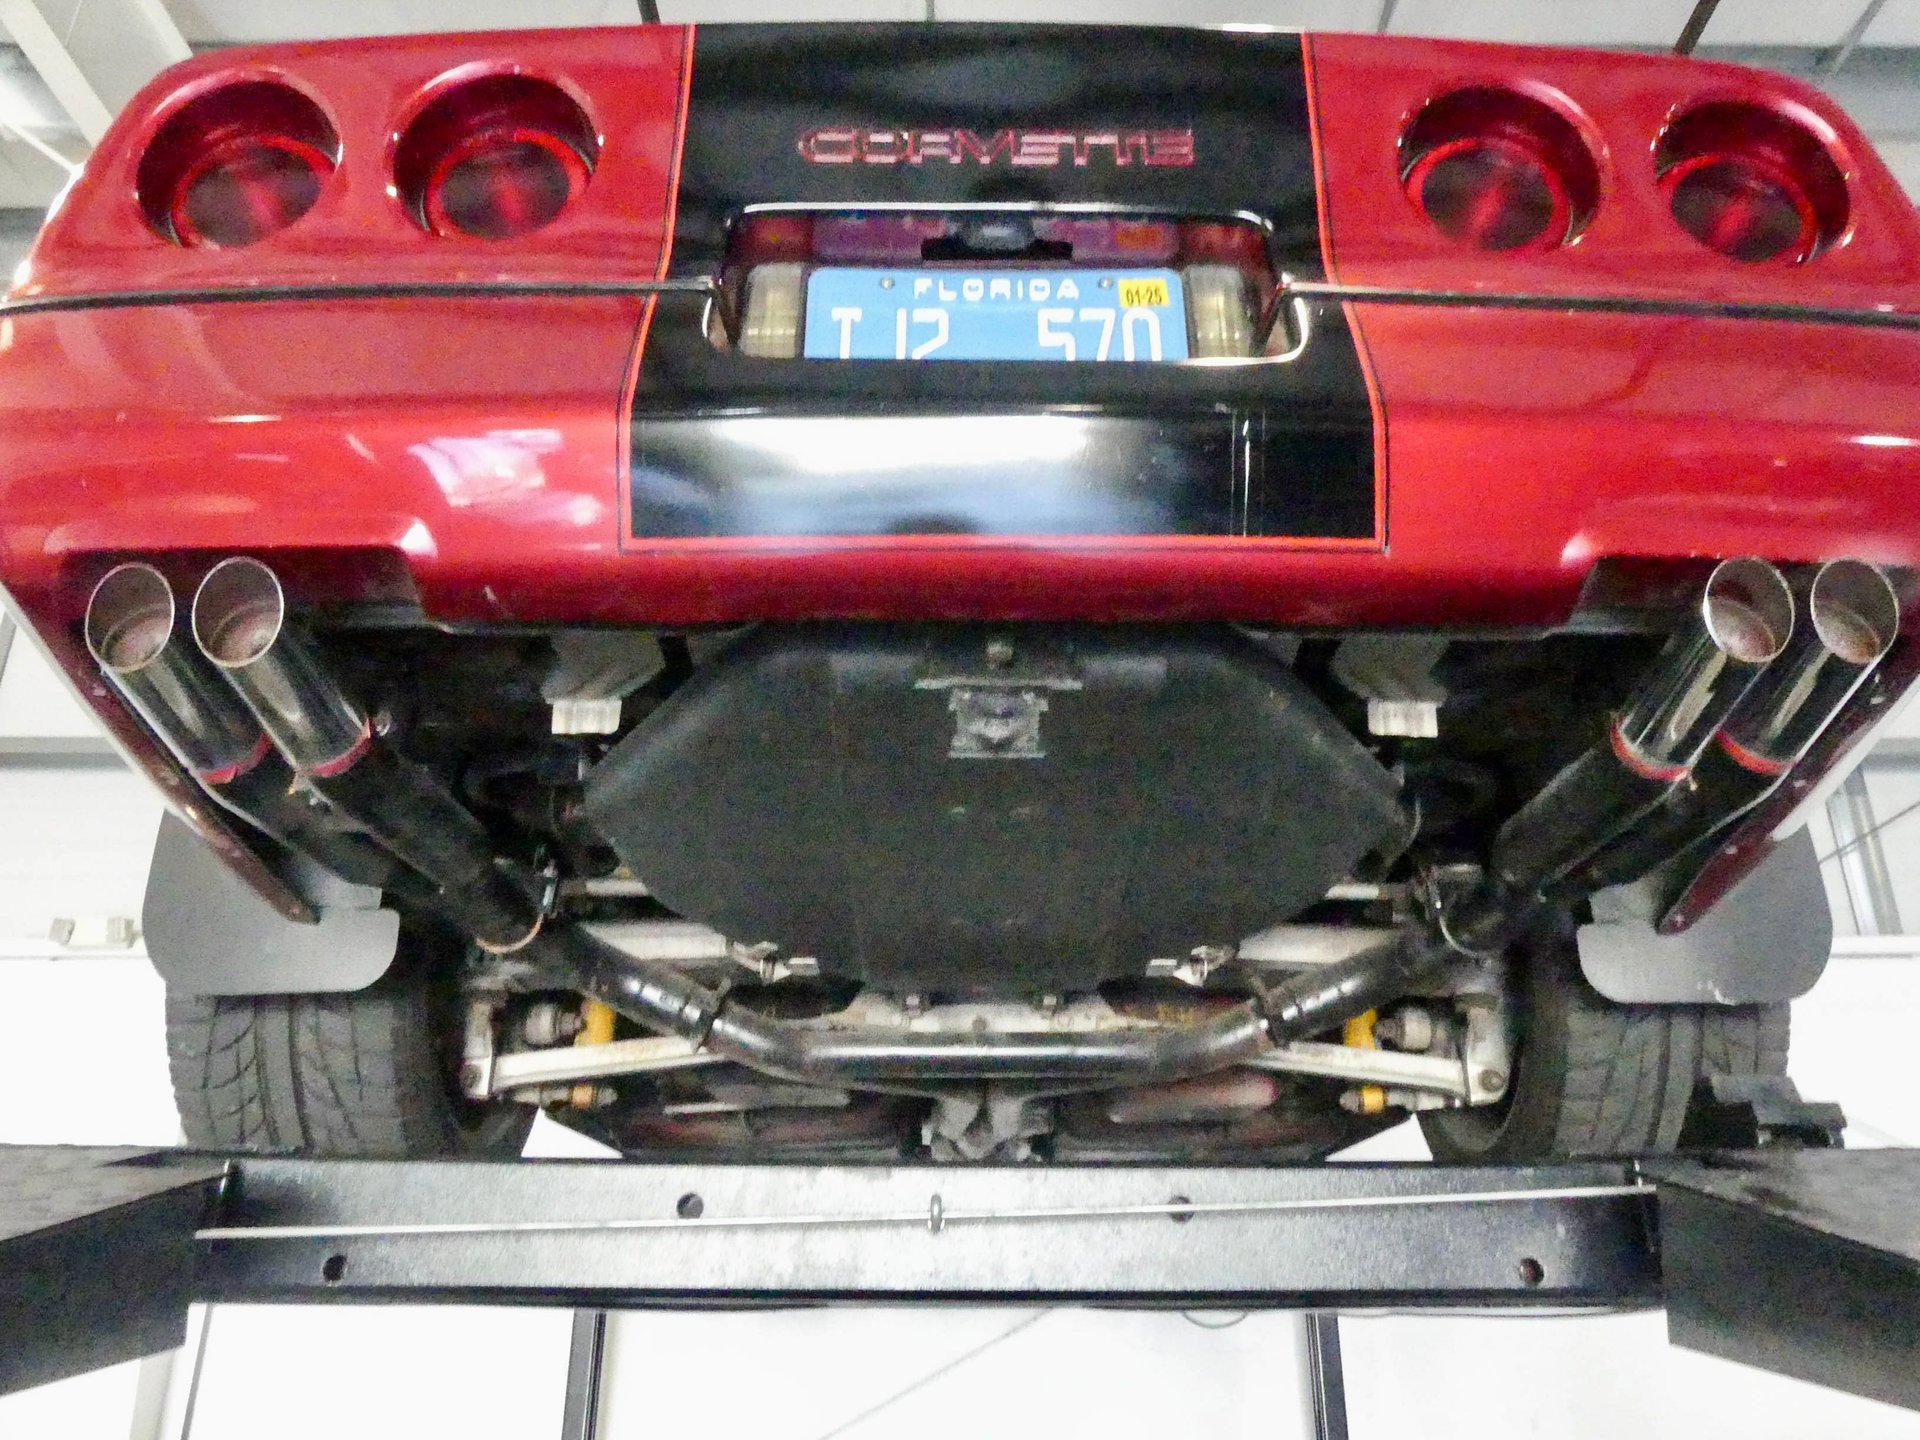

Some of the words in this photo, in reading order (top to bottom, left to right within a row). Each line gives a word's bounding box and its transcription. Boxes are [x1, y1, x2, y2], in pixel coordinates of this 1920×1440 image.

[799, 128, 1194, 167] CORVETTE
[914, 278, 1080, 301] FLORIDA
[1125, 285, 1163, 305] 01-25
